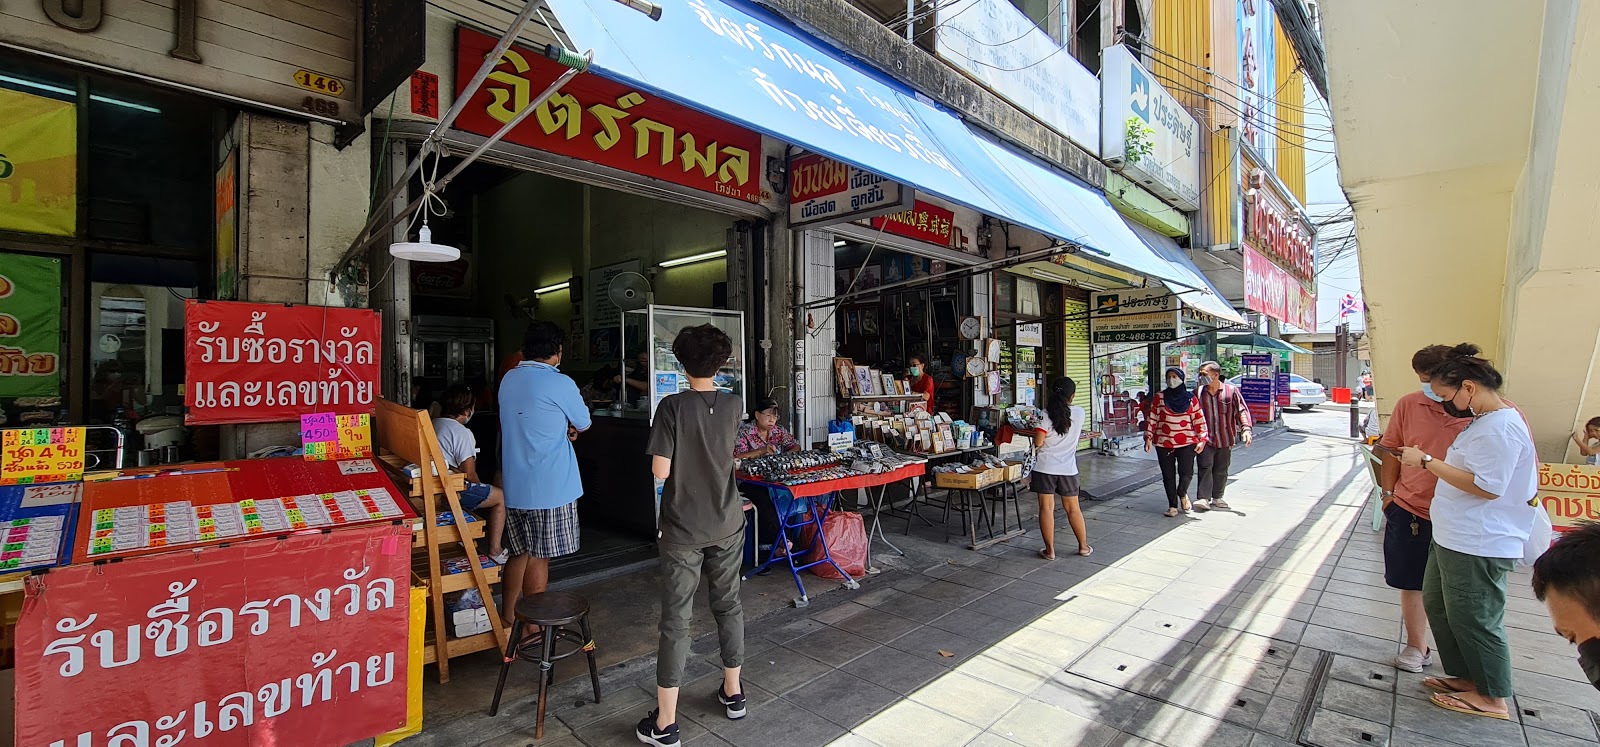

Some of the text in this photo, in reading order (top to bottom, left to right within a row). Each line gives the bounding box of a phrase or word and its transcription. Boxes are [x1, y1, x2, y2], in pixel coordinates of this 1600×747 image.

[303, 73, 338, 93] 146
[484, 49, 750, 187] จิตร์กมล
[801, 199, 836, 218] เนื้อสด
[195, 310, 373, 365] รับซื้อรางวัล
[194, 367, 373, 408] และเลขท้าย
[7, 444, 78, 462] ชุด 4 ใบ
[1539, 463, 1600, 490] ซื้อตั๋วจ
[43, 564, 395, 678] รับซื้อรางวัล
